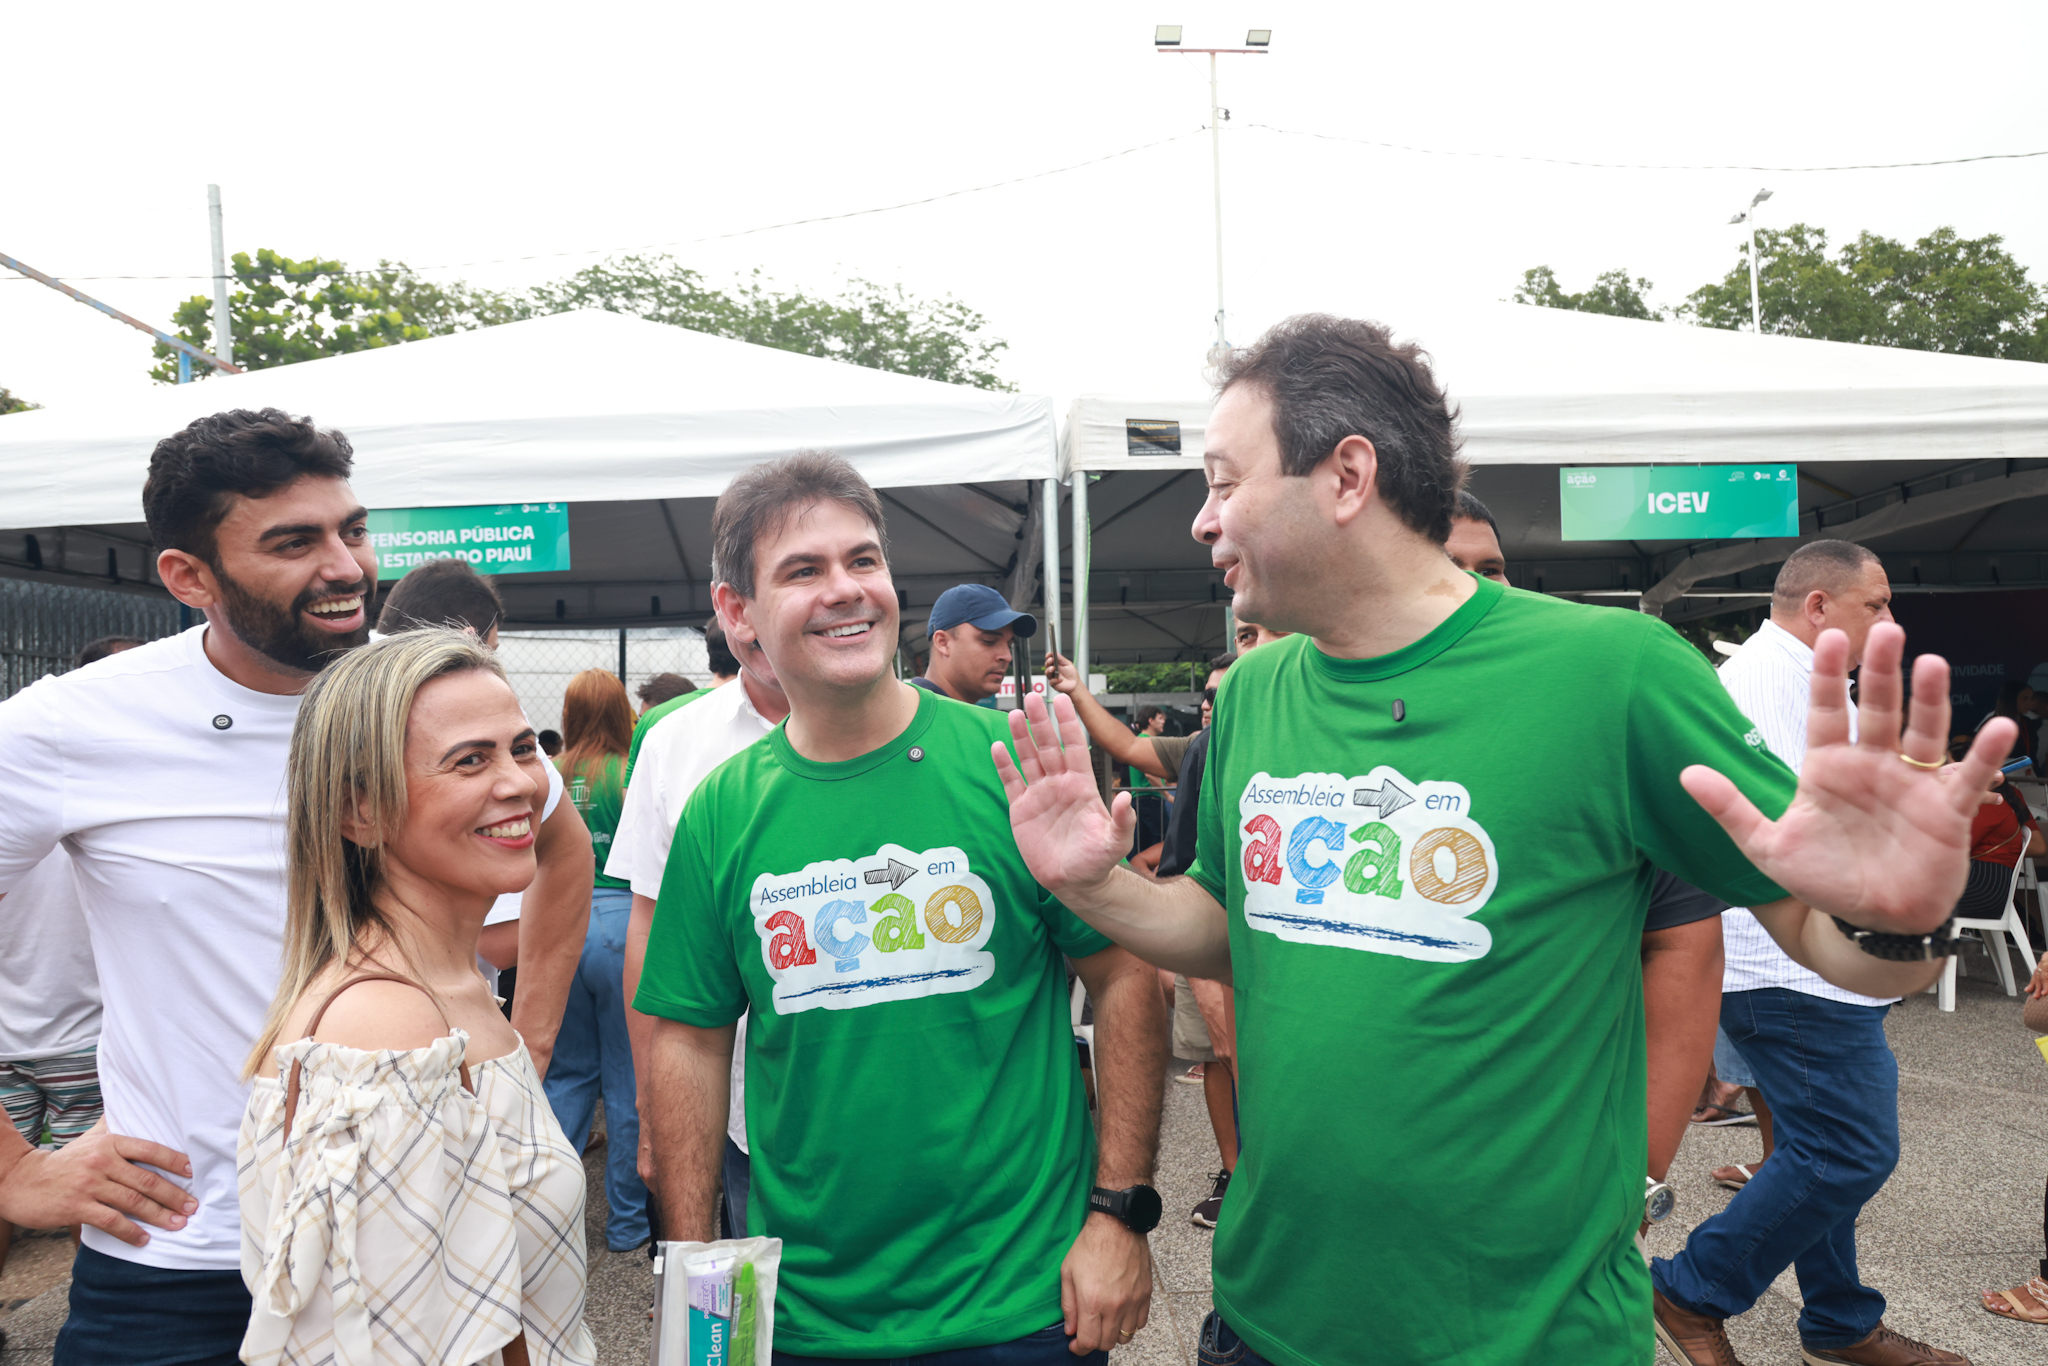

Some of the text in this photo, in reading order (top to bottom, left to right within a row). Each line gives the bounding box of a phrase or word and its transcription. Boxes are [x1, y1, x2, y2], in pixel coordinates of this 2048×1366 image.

[1648, 491, 1710, 514] ICEV
[370, 525, 535, 547] FENSORIA PÚBLICA
[455, 549, 483, 564] DO
[485, 544, 532, 563] PIAUÍ
[1950, 664, 2005, 677] TIVIDADE
[1951, 693, 1973, 706] CIA,
[1244, 783, 1460, 811] Assembleia em
[760, 860, 955, 906] Assembleia em
[707, 1322, 722, 1366] Clean
